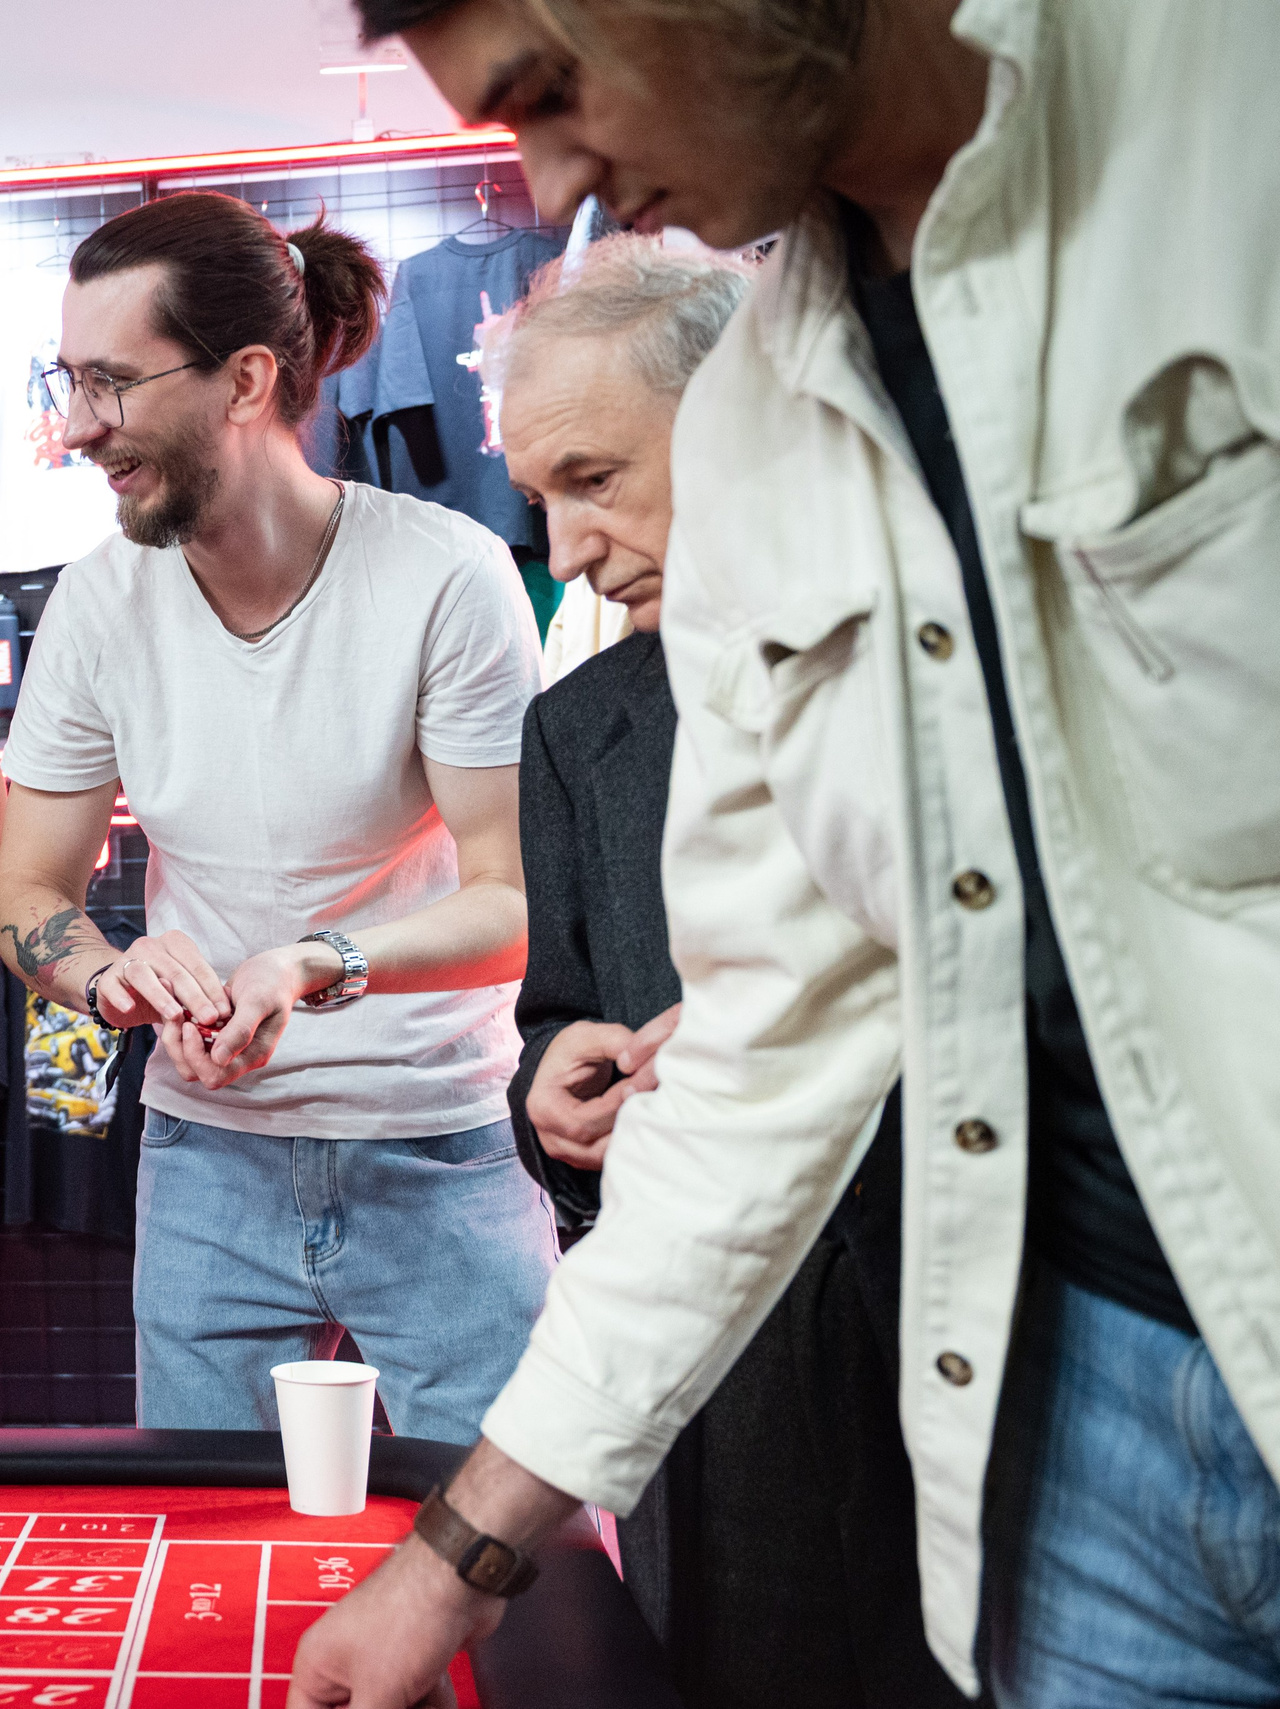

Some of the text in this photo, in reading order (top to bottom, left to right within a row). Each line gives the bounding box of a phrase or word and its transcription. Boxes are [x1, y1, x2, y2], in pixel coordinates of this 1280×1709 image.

[59, 1523, 136, 1533] 2 to 1
[313, 1556, 355, 1589] 19-36
[24, 1575, 125, 1593] 31
[5, 1606, 118, 1625] 28
